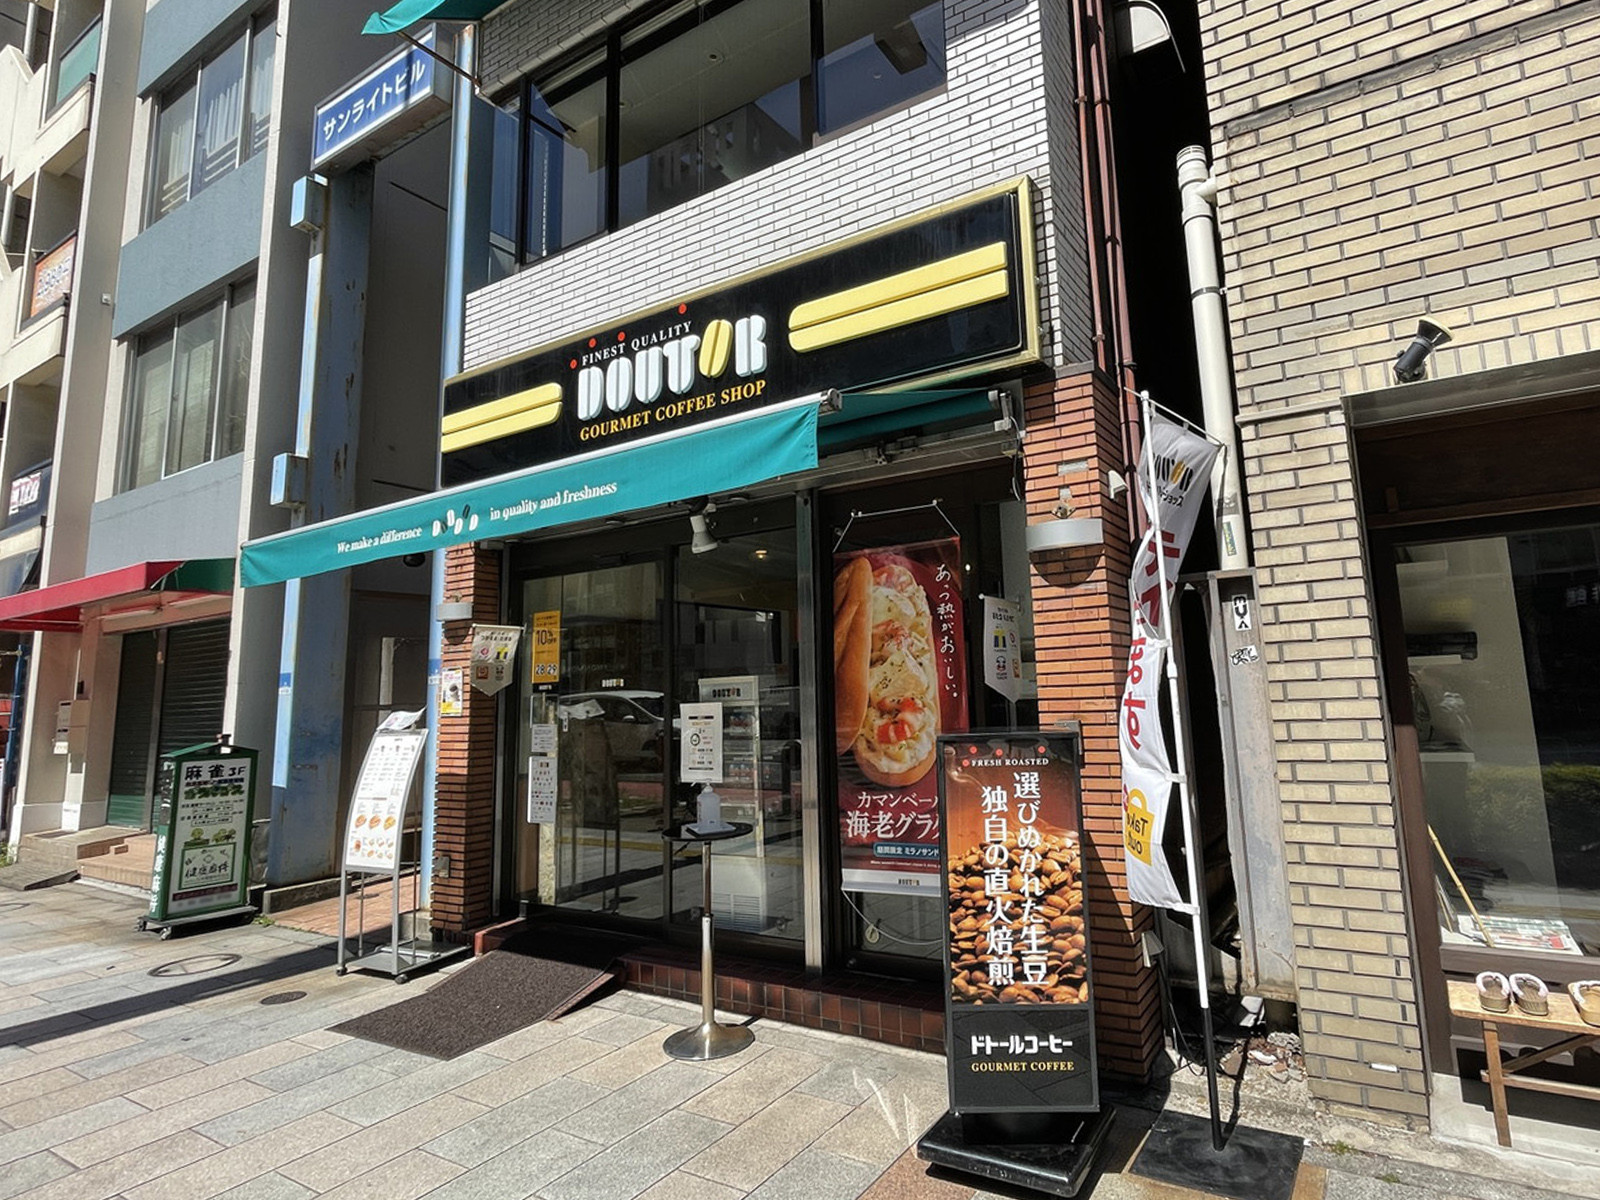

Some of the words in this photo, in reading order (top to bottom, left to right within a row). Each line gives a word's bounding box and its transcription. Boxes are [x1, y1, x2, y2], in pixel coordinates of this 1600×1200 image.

[323, 59, 426, 141] サンライトビル
[581, 342, 626, 366] FINEST
[631, 320, 692, 351] QUALITY
[578, 314, 768, 421] DOUTOR
[579, 410, 652, 441] GOURMET
[655, 392, 716, 422] COFFEE
[720, 379, 767, 405] SHOP
[490, 507, 500, 520] in
[502, 499, 538, 521] quality
[540, 491, 561, 509] and
[562, 482, 618, 505] freshness
[337, 541, 350, 554] We
[350, 536, 373, 551] make
[373, 537, 379, 546] a
[379, 527, 423, 545] difference
[185, 764, 225, 780] 麻雀
[228, 766, 246, 777] 3F
[971, 759, 1002, 767] FRESH
[1005, 757, 1049, 766] ROASTED
[981, 785, 1016, 986] 独自の直火焙煎
[1013, 771, 1050, 986] 選びぬかれた生豆
[971, 1034, 1073, 1055] ドトールコーヒー
[971, 1062, 1027, 1072] GOURMET
[1030, 1061, 1074, 1071] COFFEE
